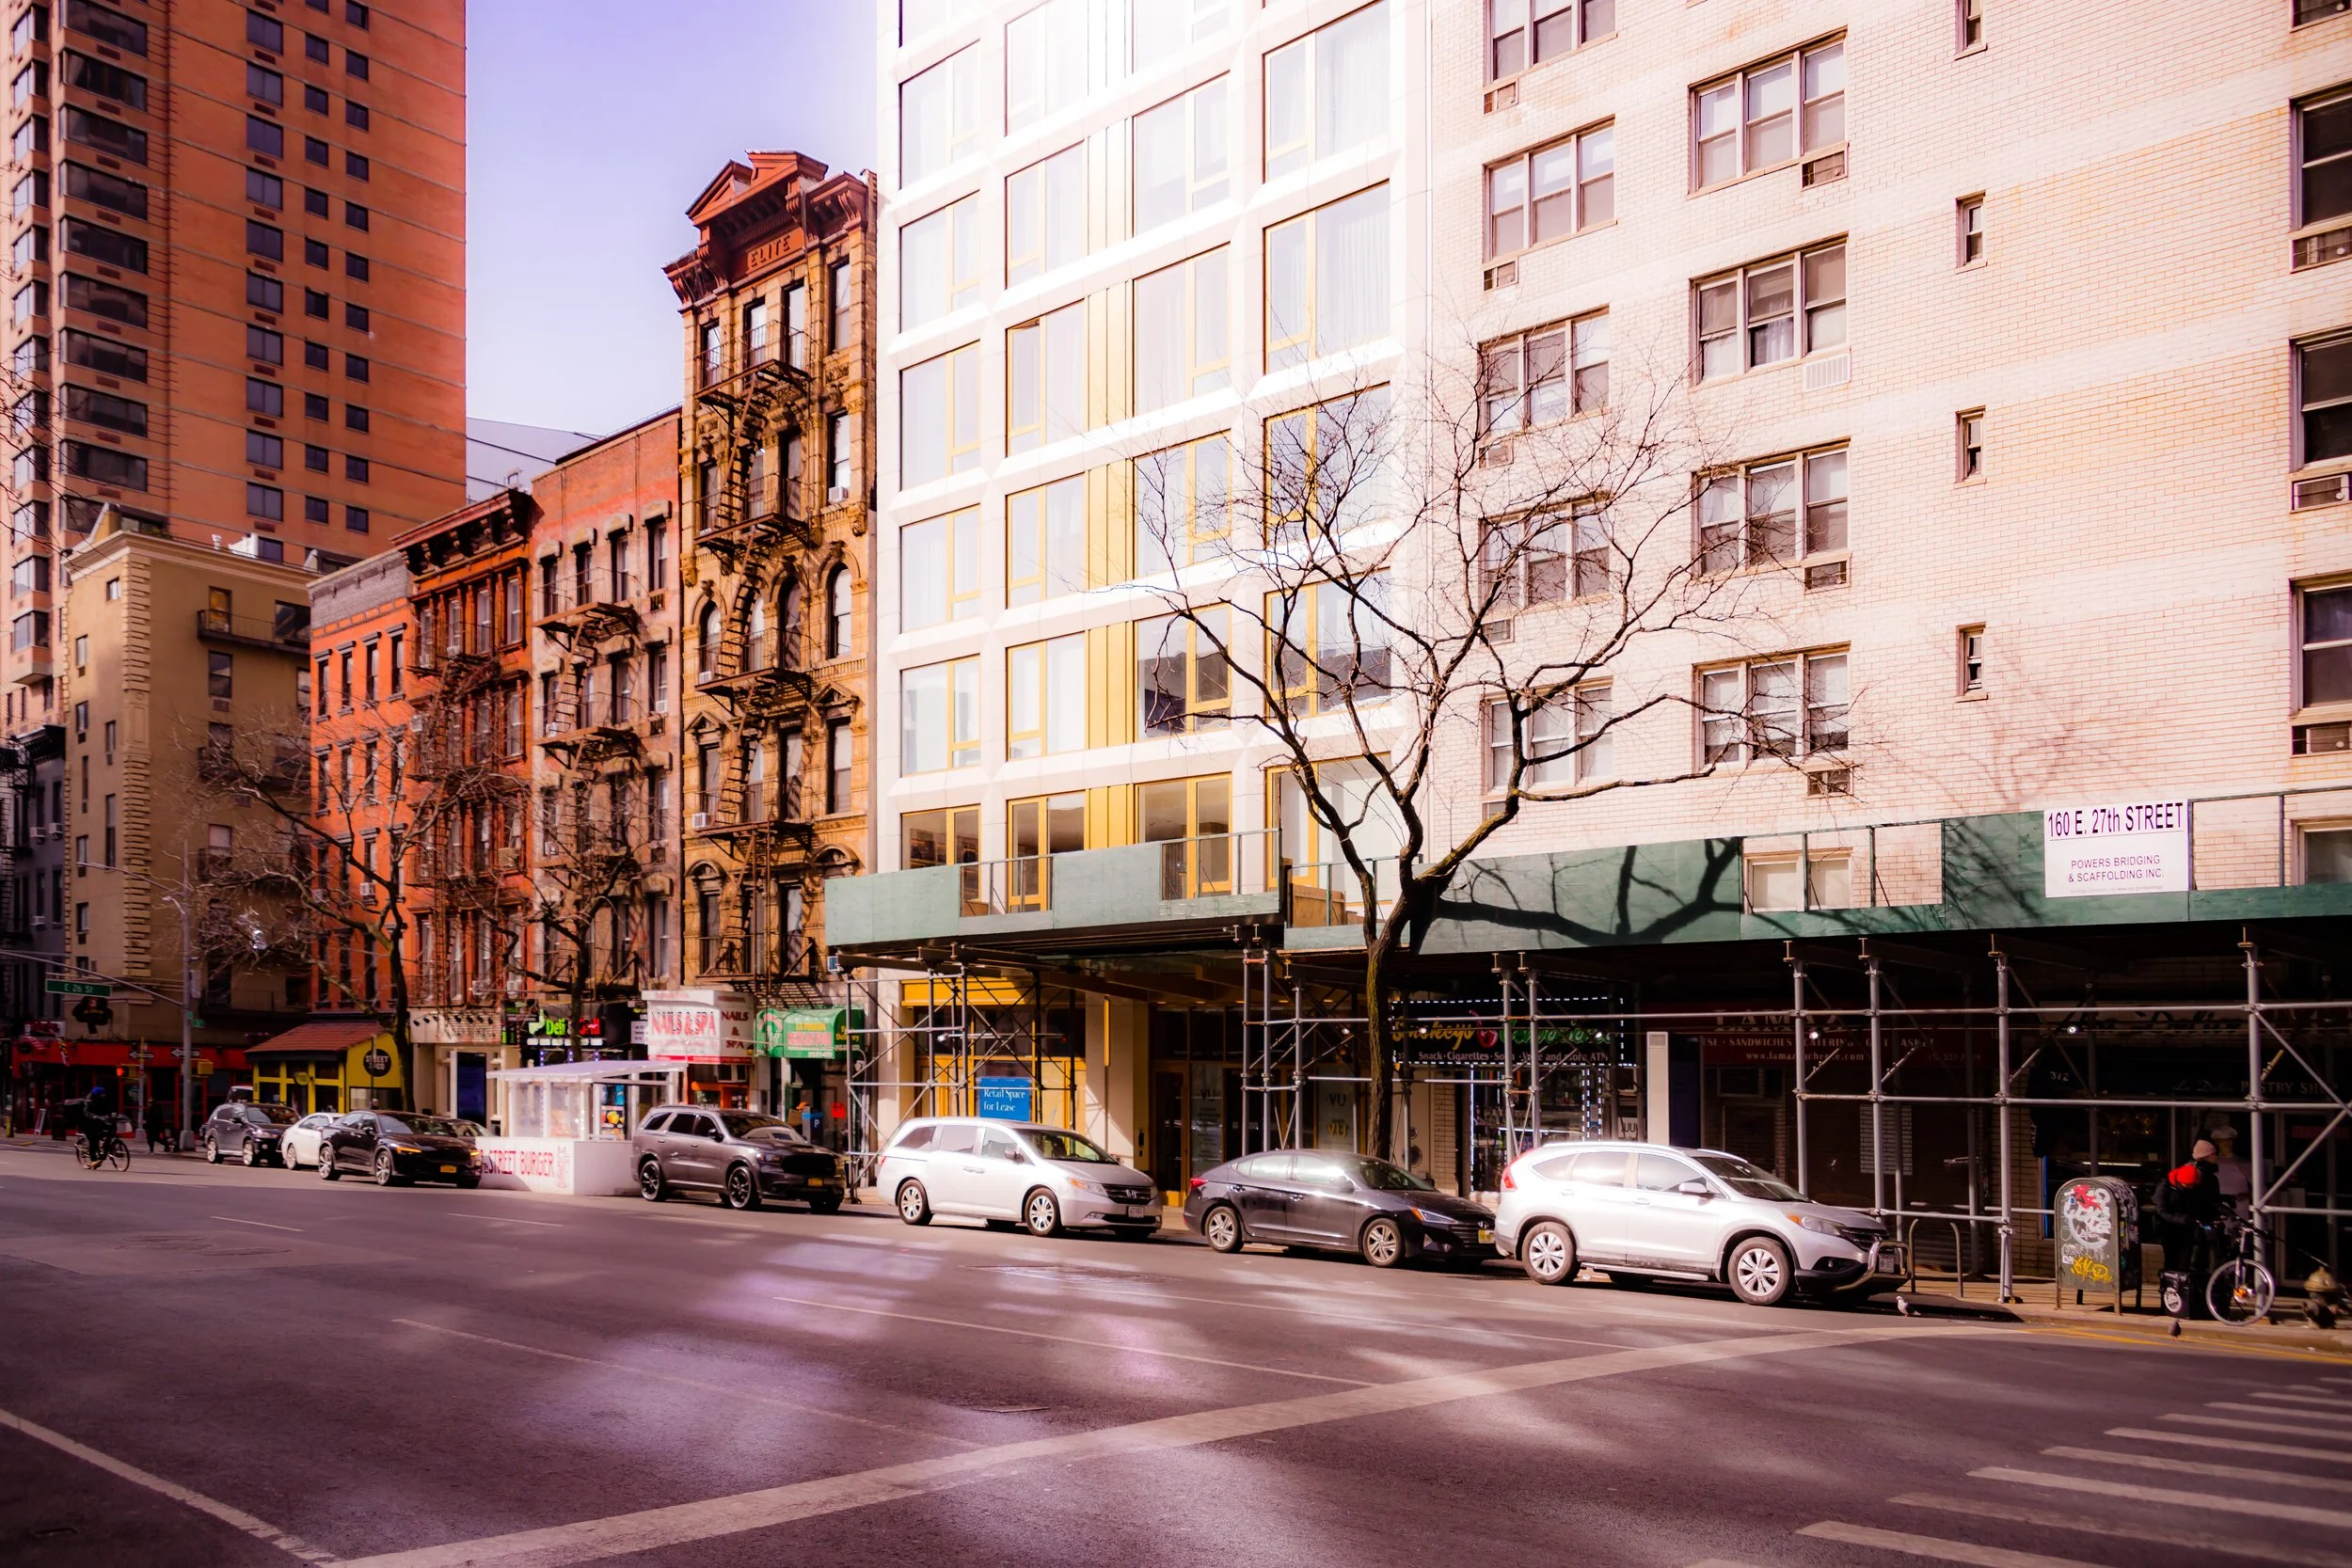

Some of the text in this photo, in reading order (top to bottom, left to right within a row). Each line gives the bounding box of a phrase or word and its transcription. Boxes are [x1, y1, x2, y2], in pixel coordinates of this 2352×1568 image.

[749, 234, 791, 269] ELITE
[2048, 802, 2184, 837] 160 E. 27th STREET
[2071, 854, 2161, 869] POWERS BRIDGING
[2068, 867, 2165, 883] & SCAFFOLDING INC.
[64, 983, 70, 991] E
[651, 1011, 682, 1035] NAILS
[685, 1011, 693, 1035] &
[695, 1011, 717, 1035] SPA
[722, 1010, 749, 1022] NAILS
[546, 1018, 565, 1035] Deli
[725, 1039, 744, 1050] SPA
[1729, 1037, 1793, 1047] SANDWICHES
[1418, 1052, 1443, 1061] Snack
[1447, 1052, 1489, 1061] Cigarettes
[1546, 1052, 1562, 1061] and
[984, 1087, 1025, 1101] Retail Space
[2240, 1081, 2294, 1094] PSTRY
[983, 1101, 1016, 1112] for Lease
[1328, 1093, 1347, 1107] VU
[520, 1150, 554, 1178] BURGER
